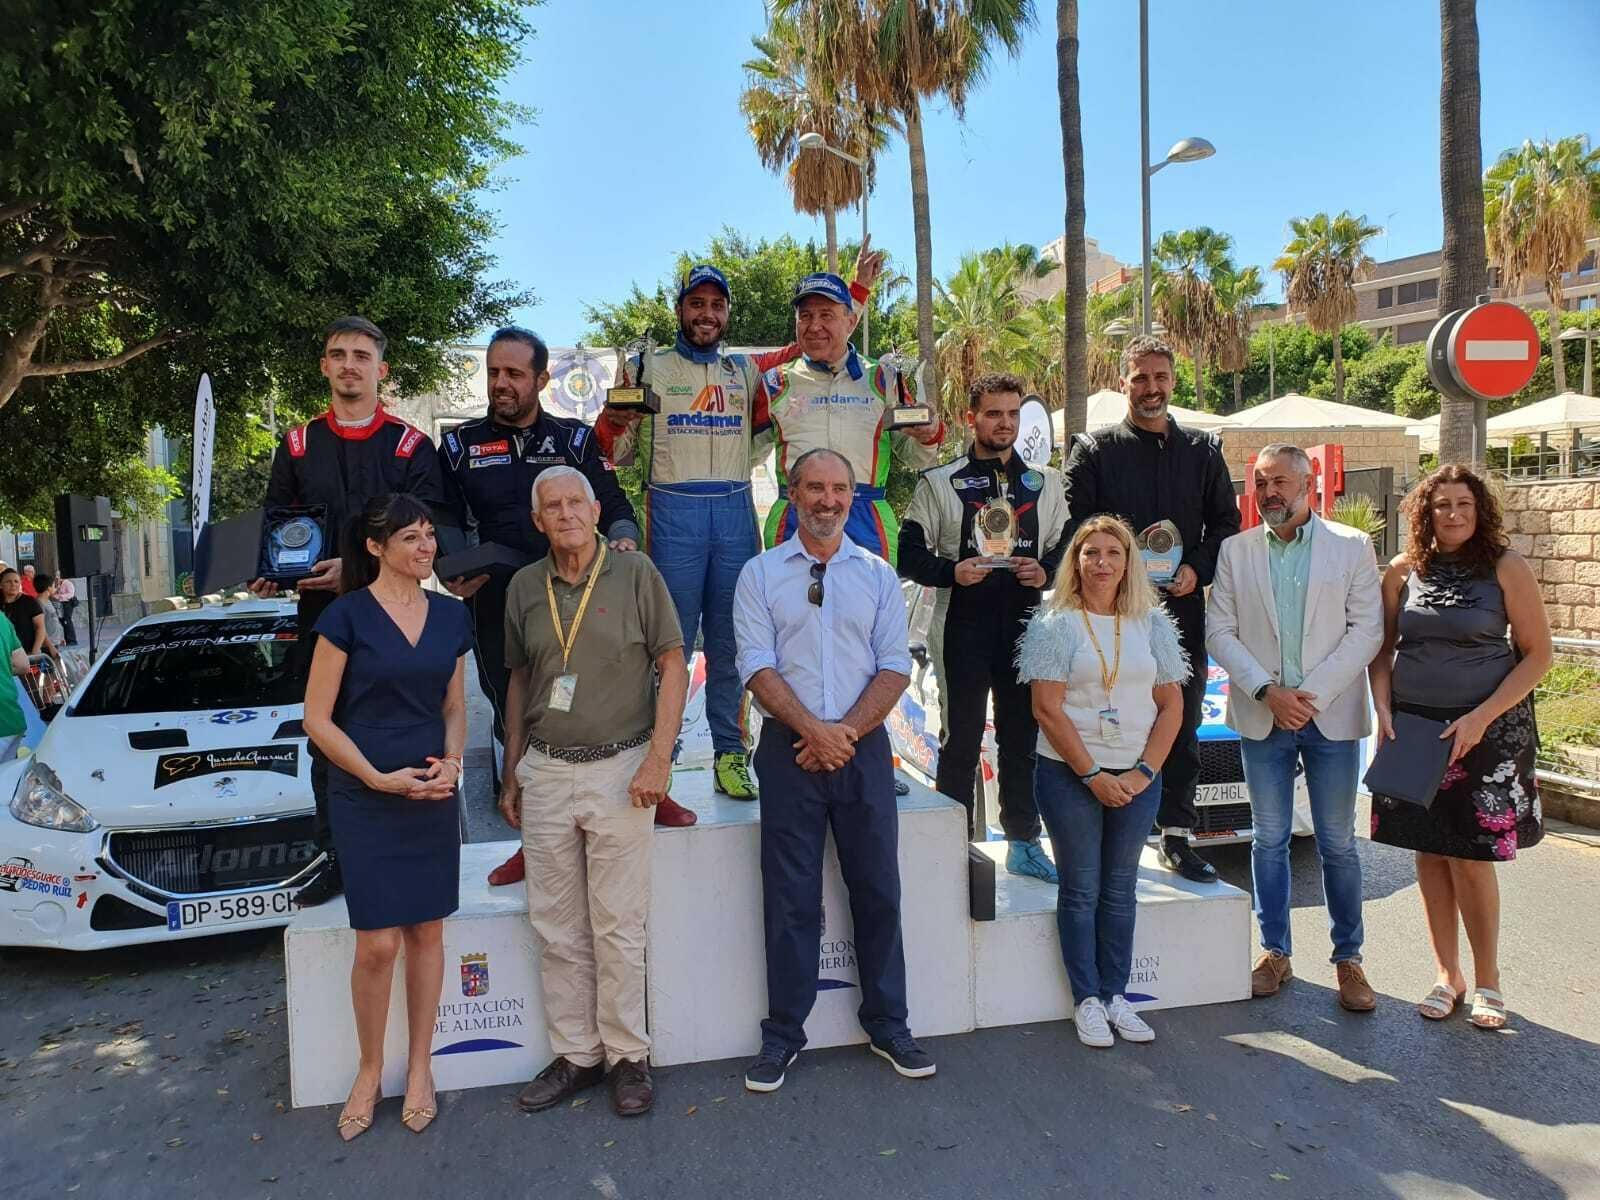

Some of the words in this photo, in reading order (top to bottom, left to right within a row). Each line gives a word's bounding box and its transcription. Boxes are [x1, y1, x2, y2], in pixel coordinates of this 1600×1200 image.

[666, 411, 743, 427] andamur
[1022, 425, 1041, 462] oba
[22, 878, 51, 894] PEDRO
[52, 884, 73, 898] RUIZ
[820, 938, 856, 954] CIÓN
[436, 996, 525, 1018] IPUTACIÓN
